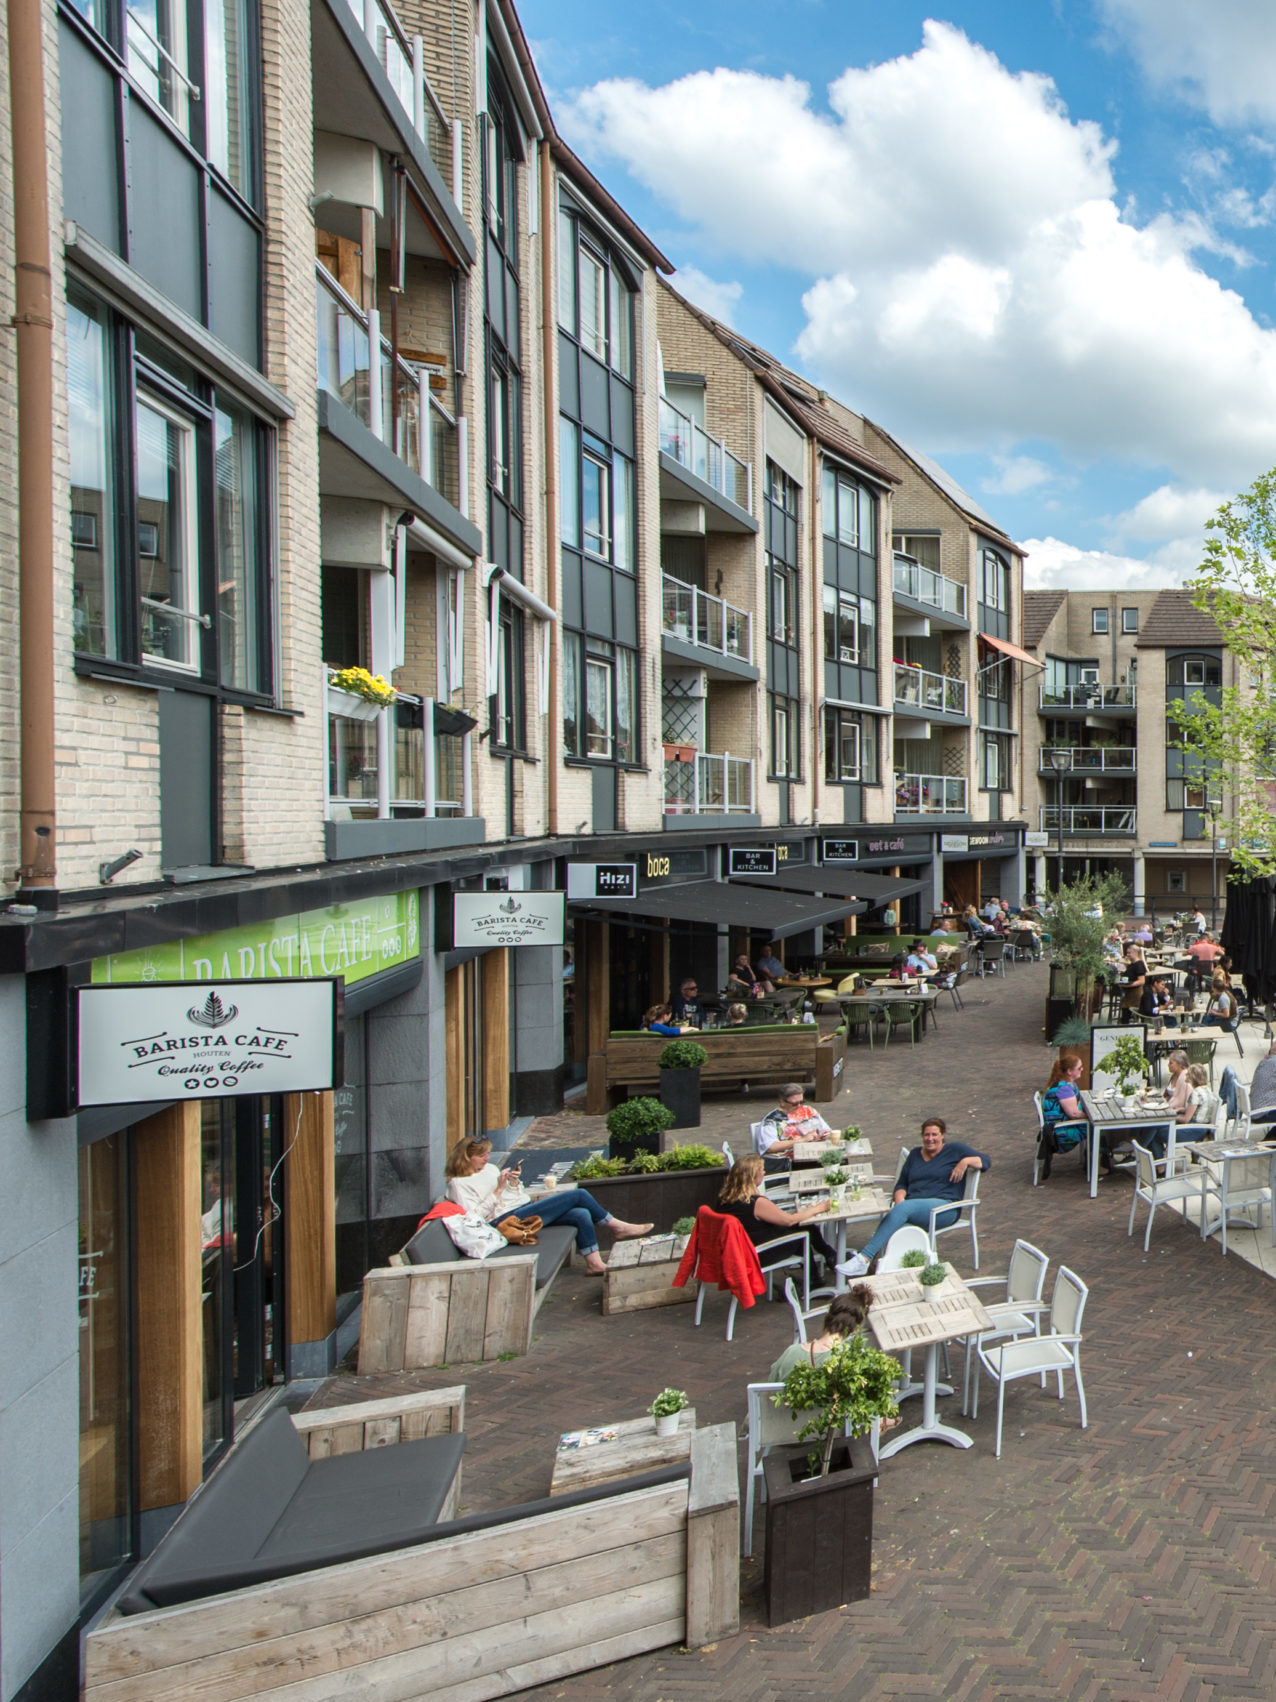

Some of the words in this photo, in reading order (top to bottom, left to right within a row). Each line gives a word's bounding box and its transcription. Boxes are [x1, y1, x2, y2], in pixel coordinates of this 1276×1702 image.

[647, 852, 670, 878] boca
[600, 872, 630, 884] HIZI
[477, 917, 517, 927] BARISTA
[519, 917, 544, 927] CAFE
[320, 915, 372, 975] CAFE
[133, 1035, 229, 1059] BARISTA
[234, 1034, 288, 1051] CAFE
[193, 1051, 232, 1059] HOUTEN
[157, 1061, 214, 1076] Quality
[219, 1060, 264, 1074] Coffee
[79, 1266, 96, 1286] FE
